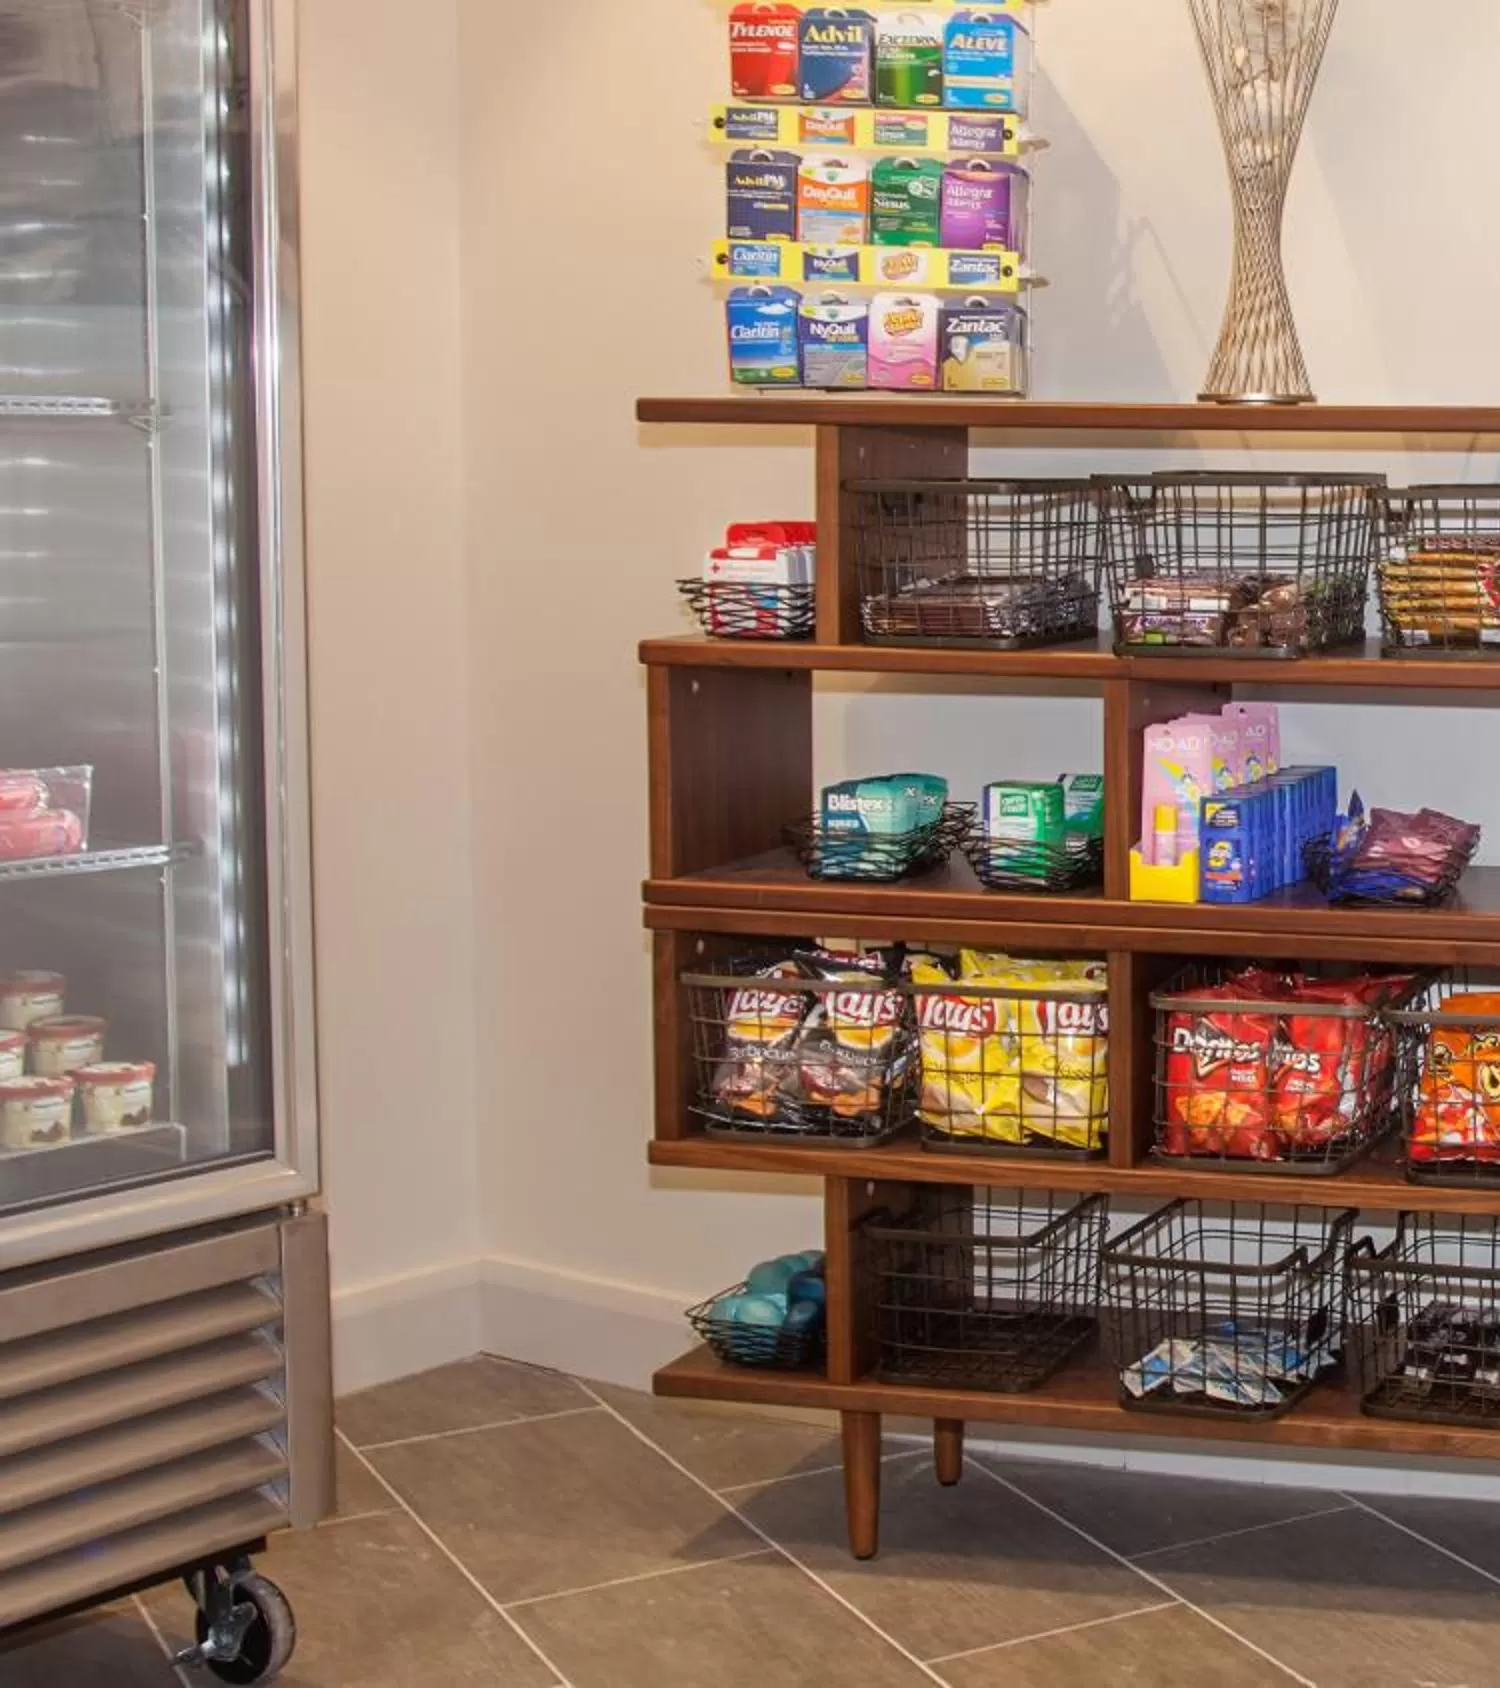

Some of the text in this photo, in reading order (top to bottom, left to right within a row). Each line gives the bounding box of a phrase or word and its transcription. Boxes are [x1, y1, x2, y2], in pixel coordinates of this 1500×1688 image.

[804, 24, 864, 43] Advil
[809, 322, 857, 339] NyQuil
[946, 317, 1005, 333] Zantac
[828, 793, 884, 812] Blistex
